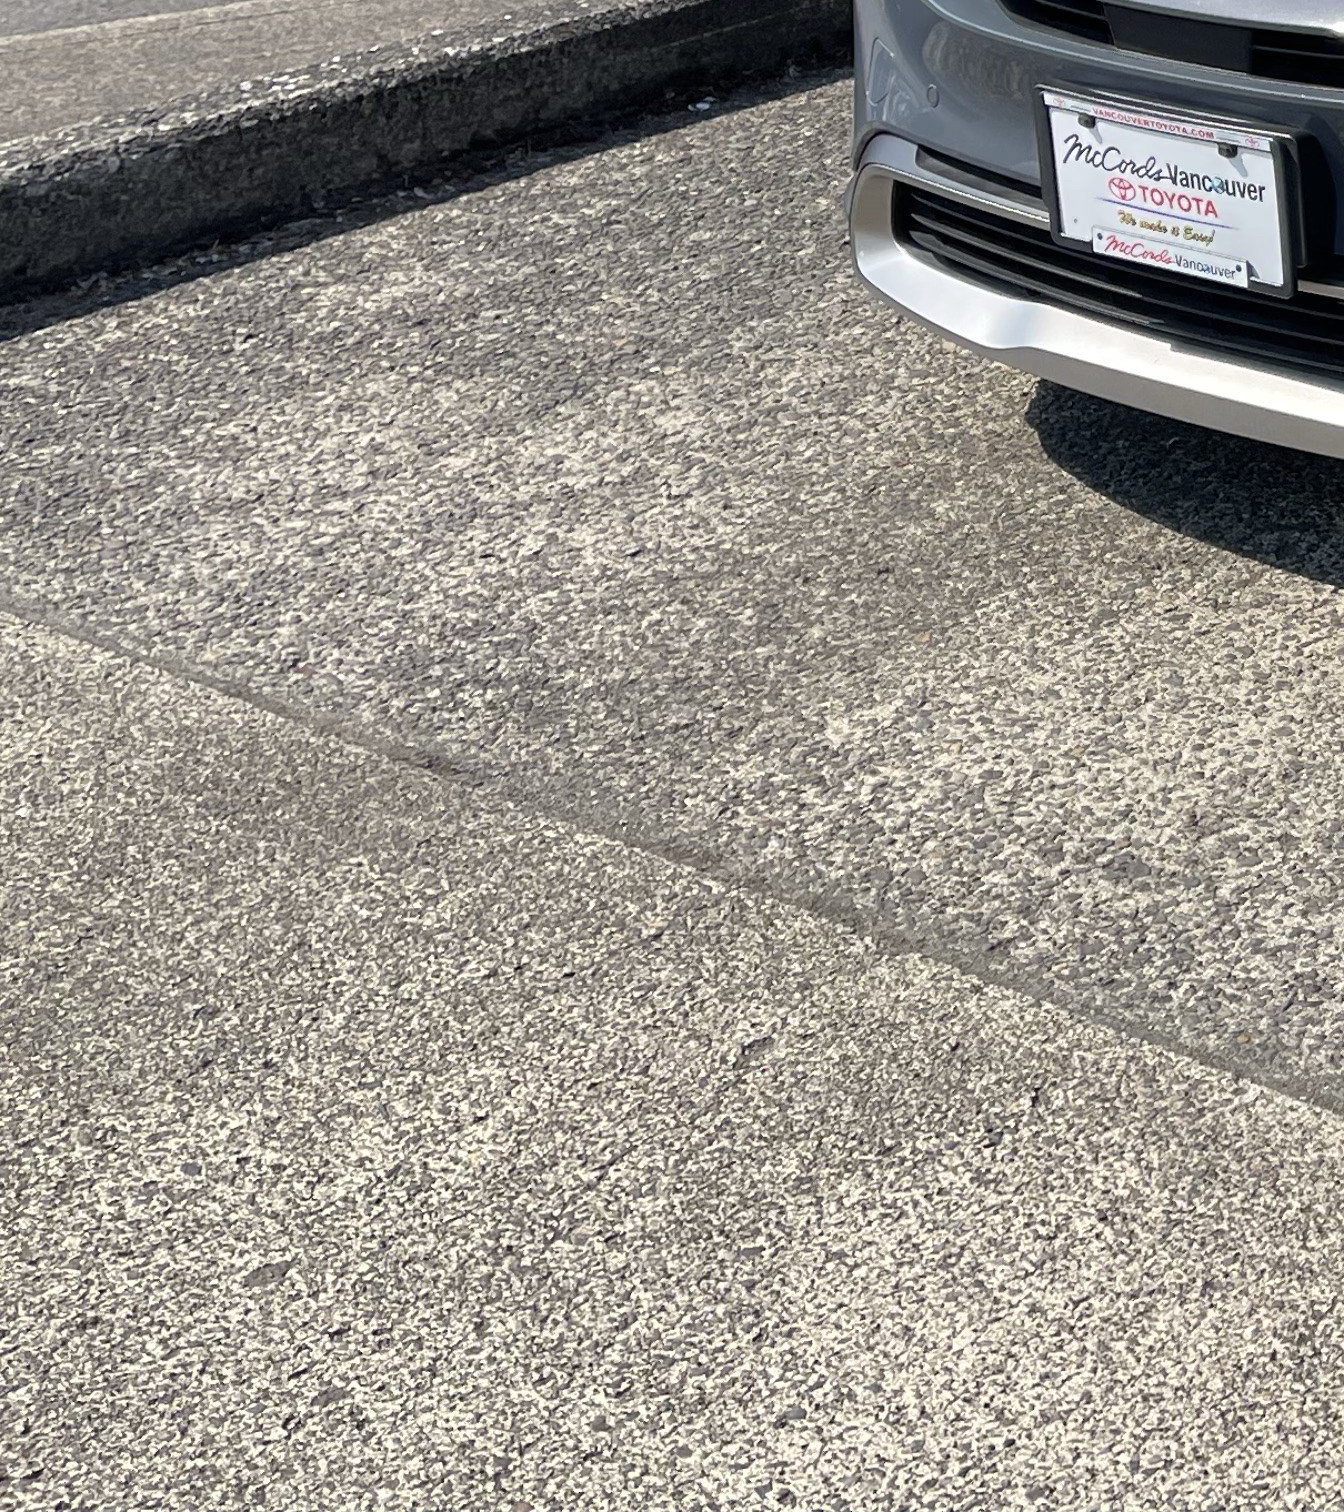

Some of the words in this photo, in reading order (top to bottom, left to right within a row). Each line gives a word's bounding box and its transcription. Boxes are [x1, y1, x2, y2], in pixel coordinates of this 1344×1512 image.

[1092, 107, 1215, 139] VANCOUVERTOYOTA.COM
[1138, 184, 1219, 218] TOYOTA
[1139, 219, 1168, 234] make
[1171, 225, 1180, 237] it
[1173, 253, 1237, 279] Vancouver
